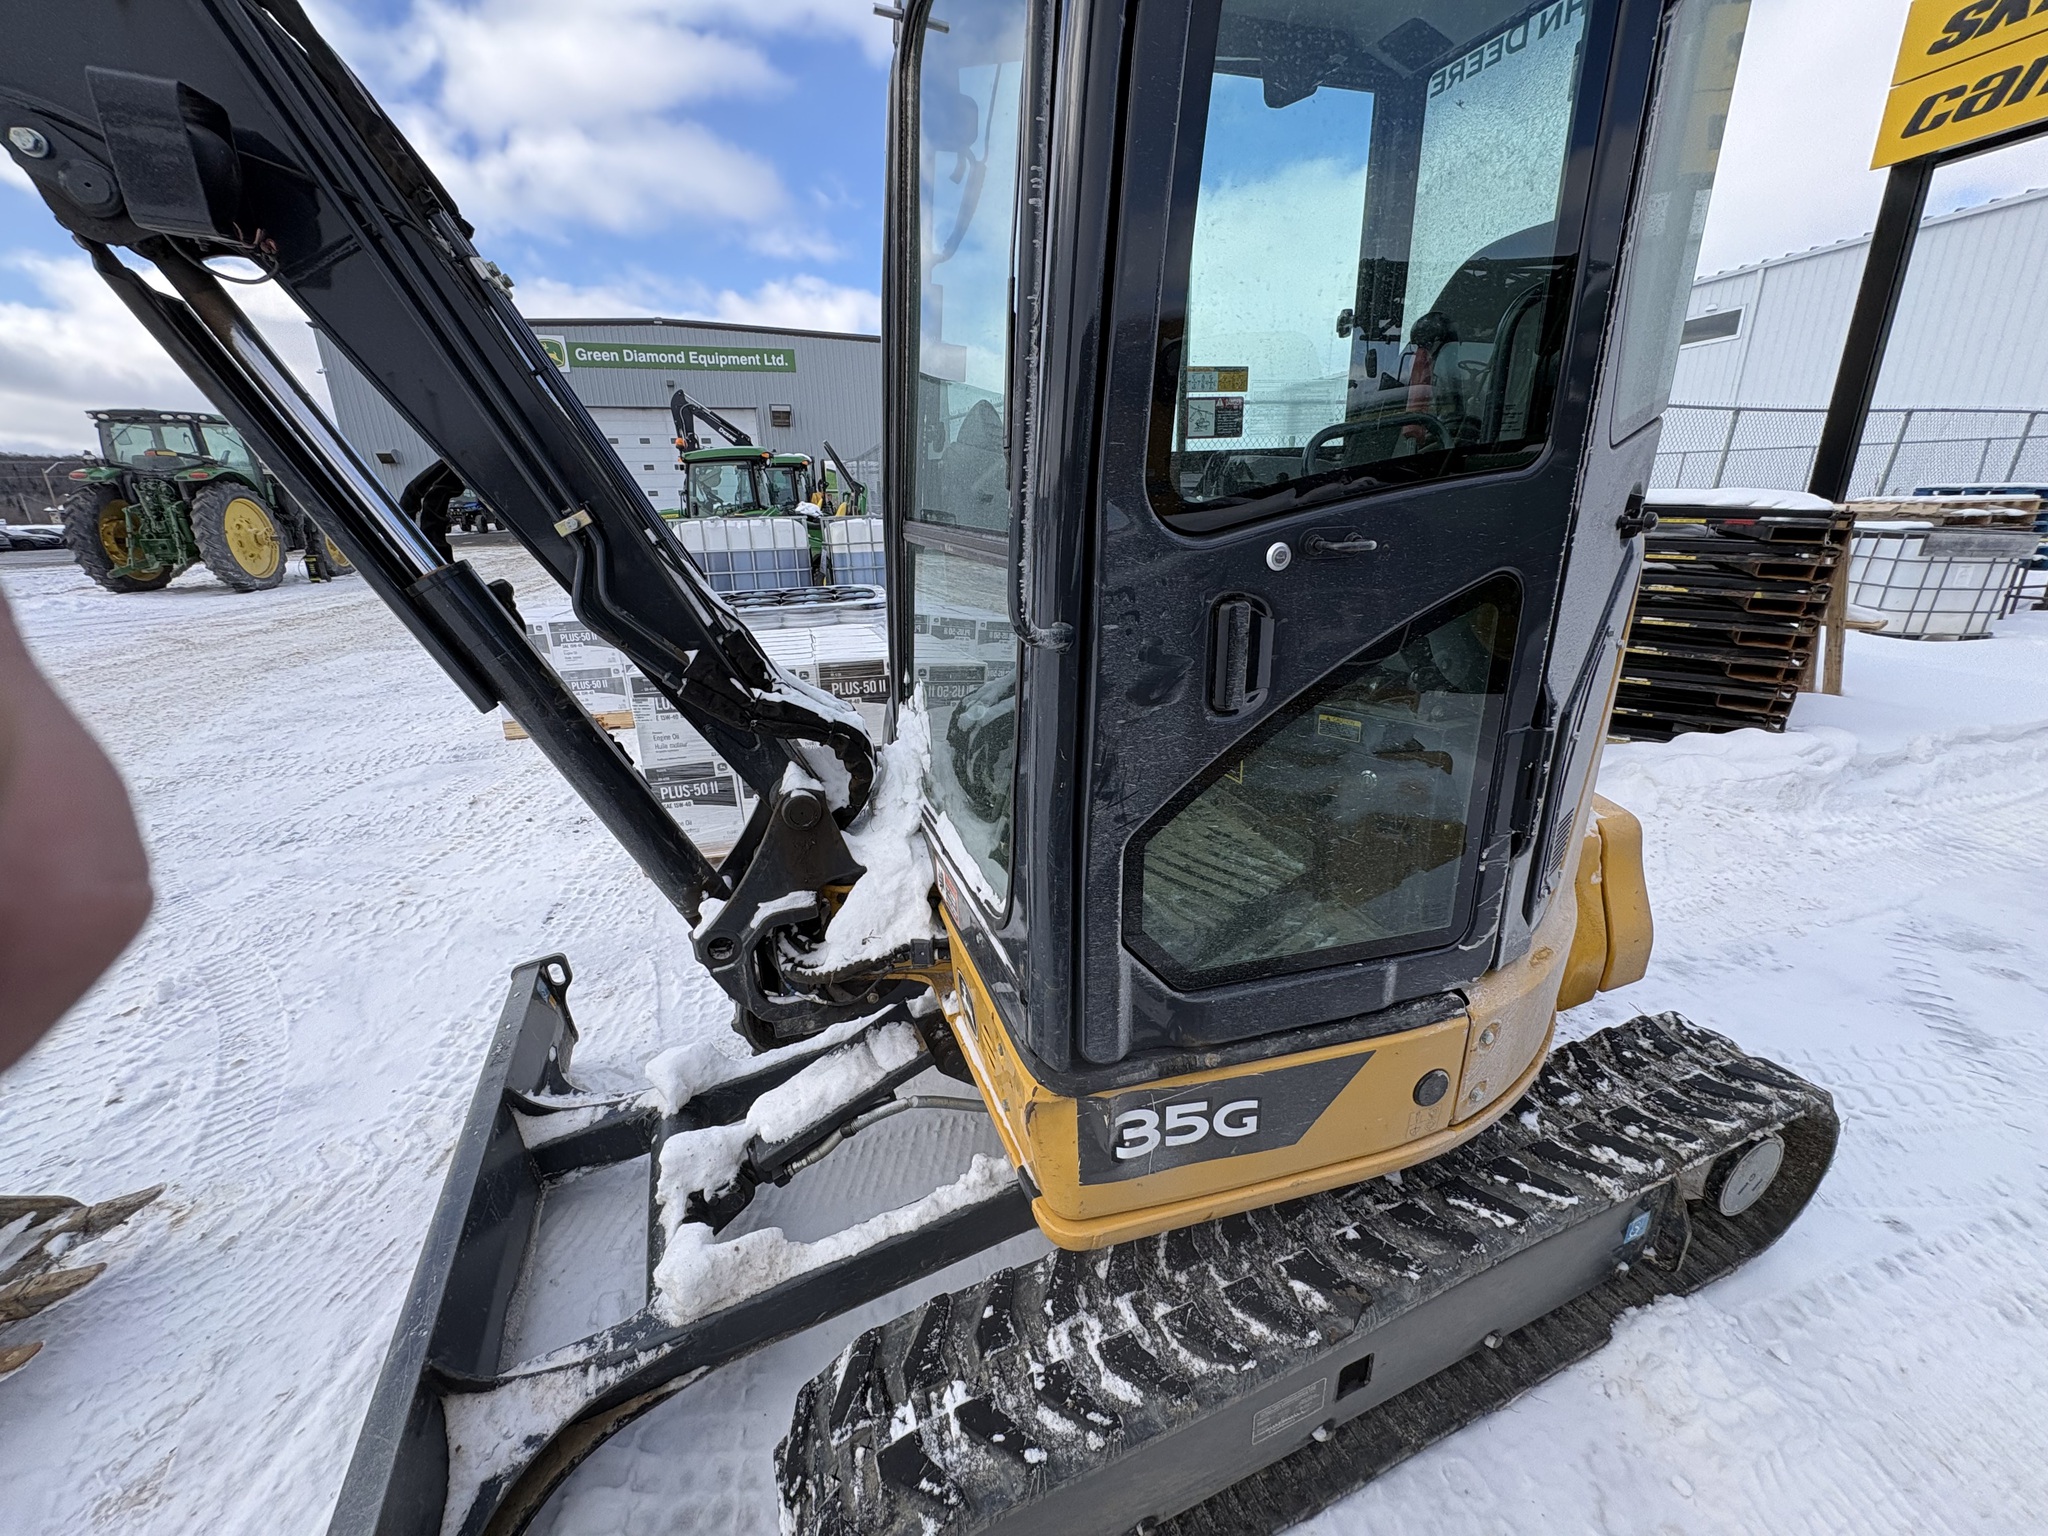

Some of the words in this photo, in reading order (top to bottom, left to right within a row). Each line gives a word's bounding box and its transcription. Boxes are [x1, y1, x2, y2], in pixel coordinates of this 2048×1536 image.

[575, 347, 619, 361] Green
[622, 349, 685, 363] Diamond
[689, 351, 760, 367] Equipment
[764, 354, 788, 367] Ltd.
[560, 632, 591, 642] PLUS-50
[571, 680, 602, 690] PLUS-50
[831, 680, 877, 696] PLUS-50
[878, 679, 886, 693] II
[660, 782, 708, 800] PLUS-50
[710, 781, 719, 794] II
[1115, 1100, 1259, 1160] 35G
